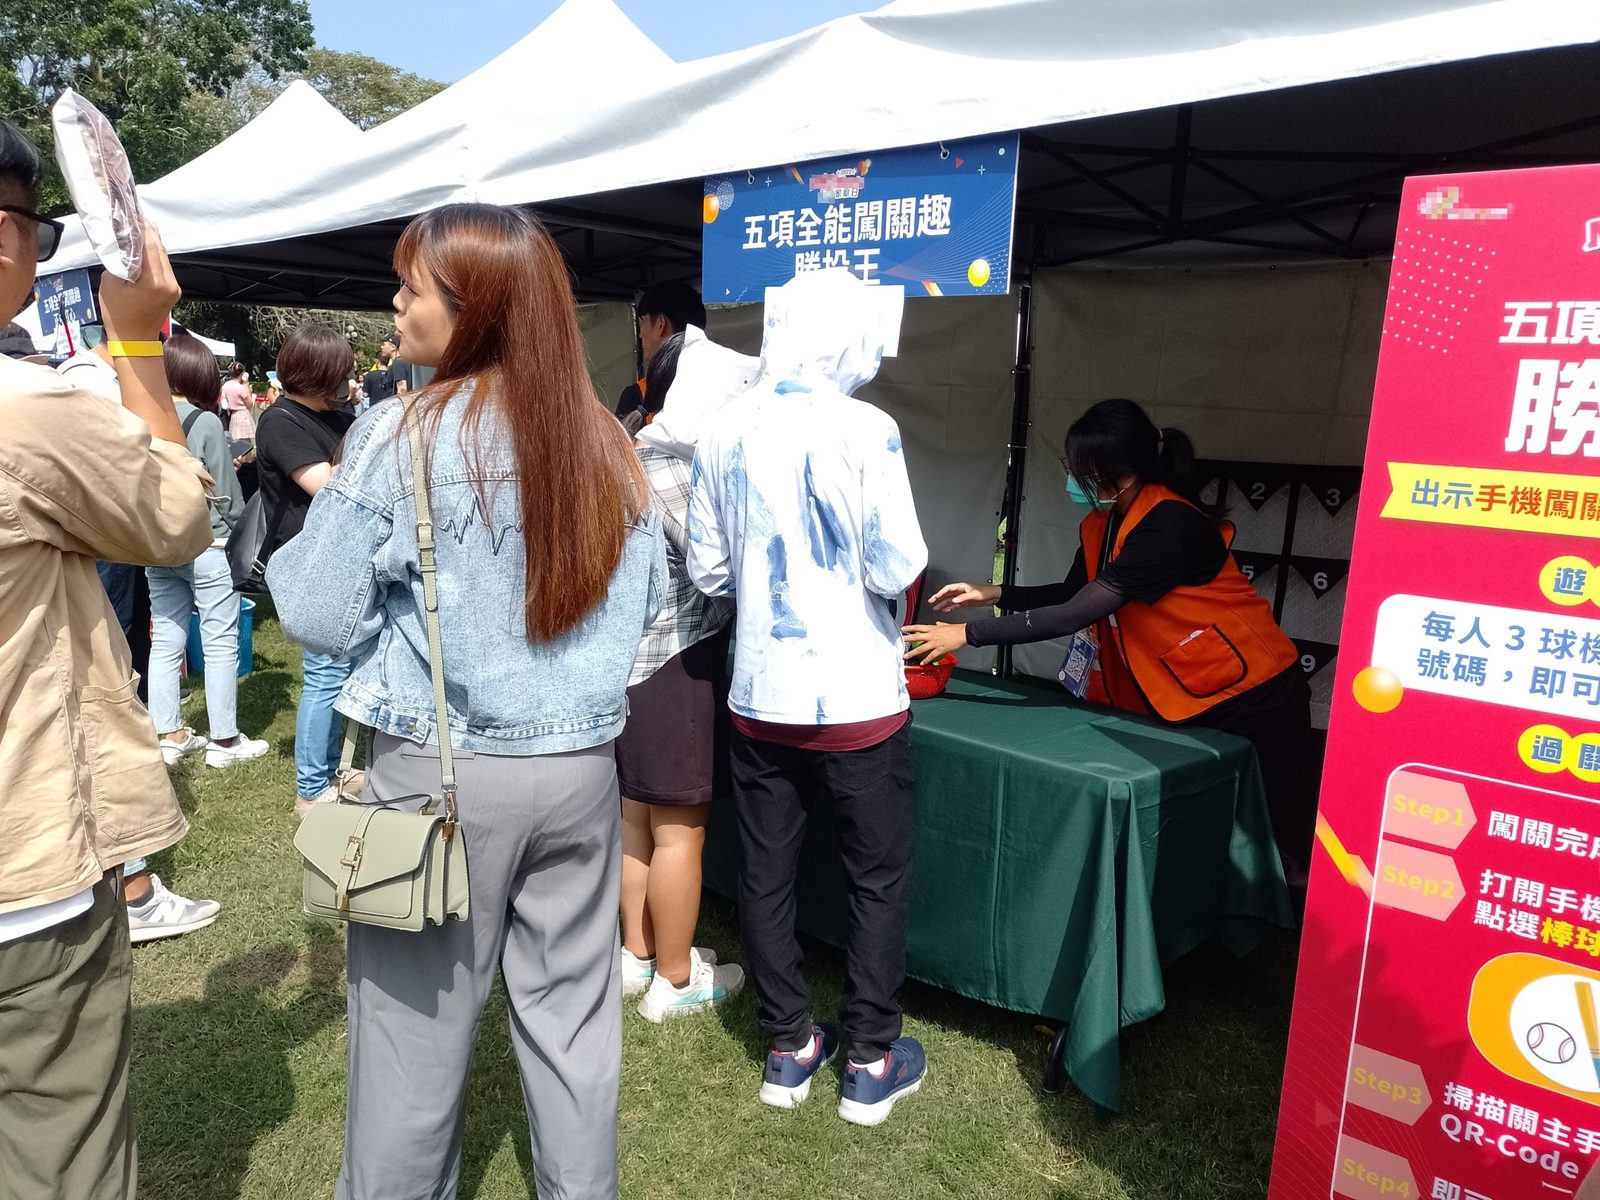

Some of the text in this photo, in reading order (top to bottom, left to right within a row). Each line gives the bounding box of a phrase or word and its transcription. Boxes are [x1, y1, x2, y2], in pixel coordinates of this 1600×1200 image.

[742, 193, 952, 250] 五項全能闖關趣
[1505, 358, 1600, 457] 勝
[1251, 482, 1265, 500] 2
[1326, 488, 1341, 506] 3
[1242, 565, 1255, 580] 5
[1313, 571, 1328, 590] 6
[1553, 567, 1587, 596] 遊
[1300, 654, 1316, 673] 9
[1392, 793, 1466, 828] Step1
[1383, 865, 1455, 898] Step2
[1353, 1066, 1423, 1105] Step3
[1440, 1113, 1579, 1179] QR-Code
[1341, 1158, 1411, 1197] Step4
